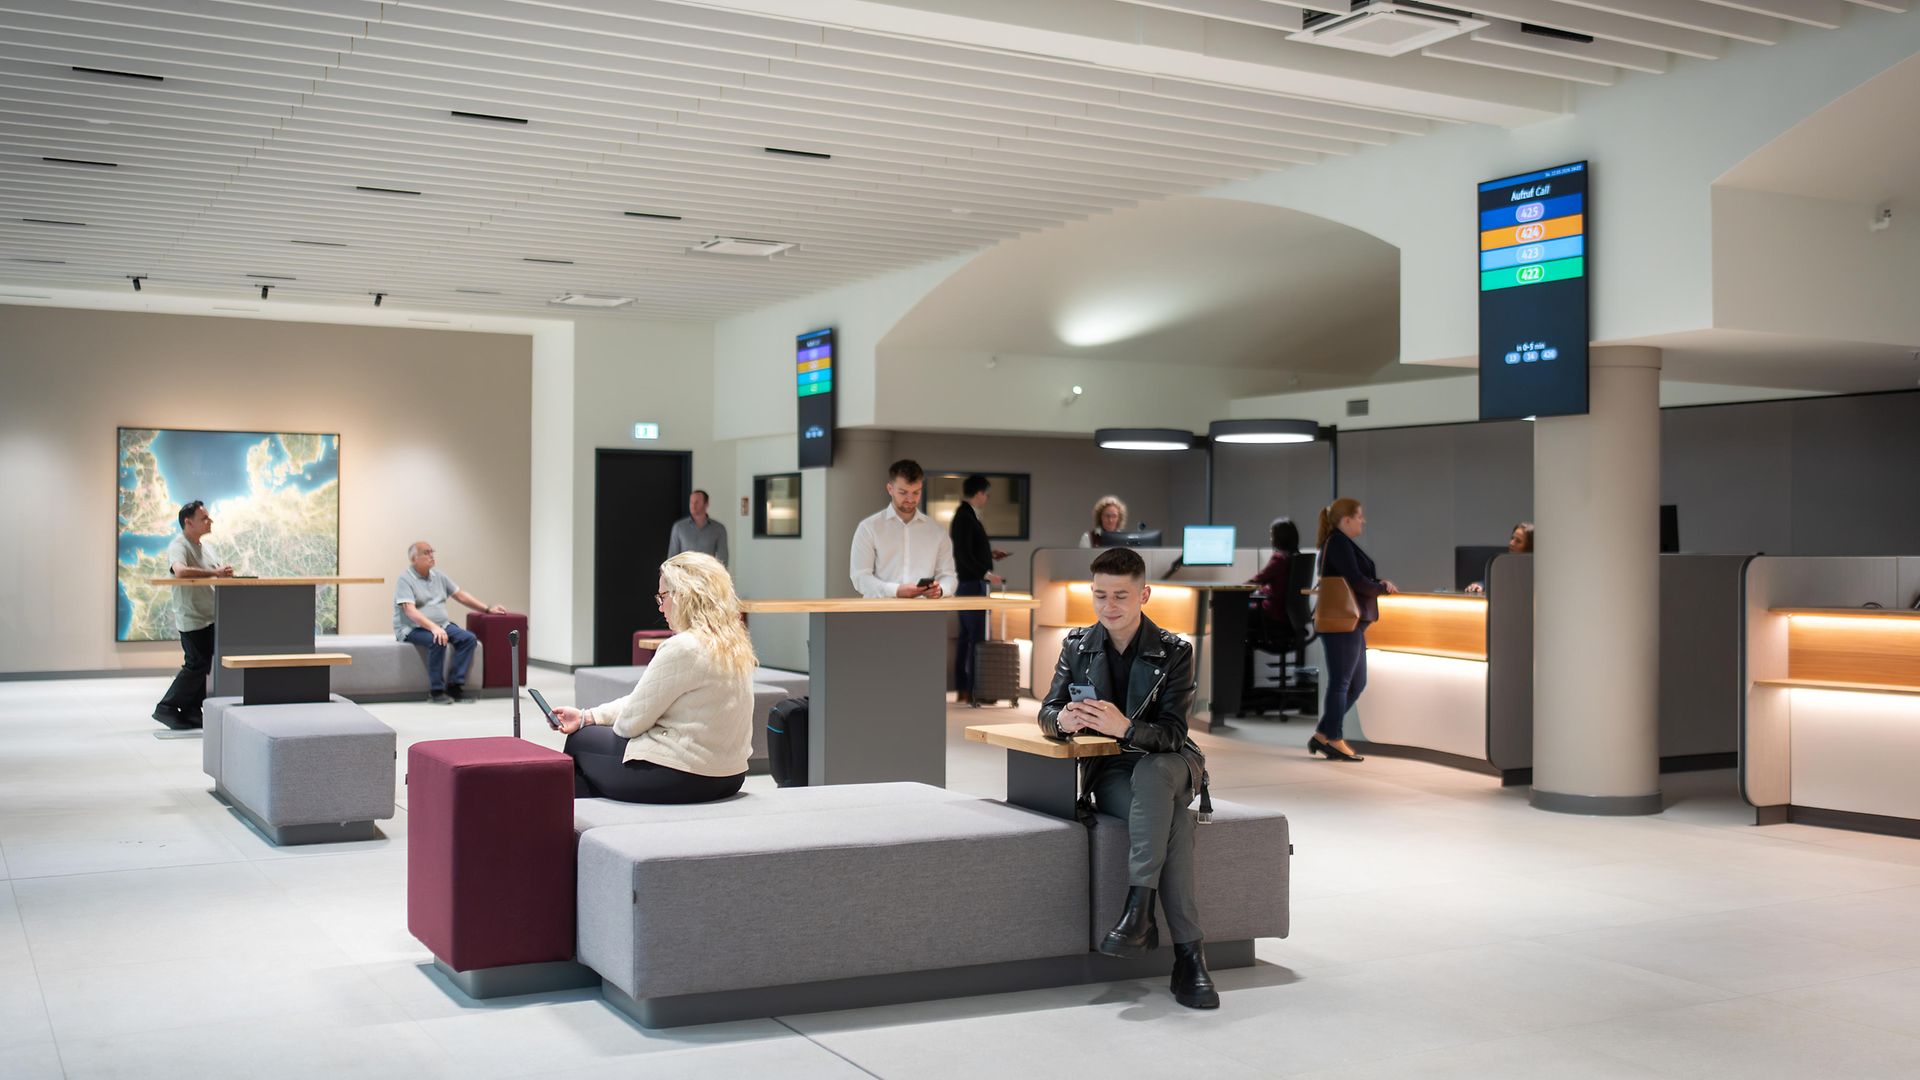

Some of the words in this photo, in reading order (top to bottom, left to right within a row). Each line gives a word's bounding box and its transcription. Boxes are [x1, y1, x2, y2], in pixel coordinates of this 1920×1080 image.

[1535, 183, 1550, 197] Call
[1521, 206, 1538, 218] 425
[1521, 227, 1539, 239] 424
[1521, 247, 1538, 259] 423
[1521, 268, 1539, 280] 422
[1522, 342, 1534, 351] 0-5
